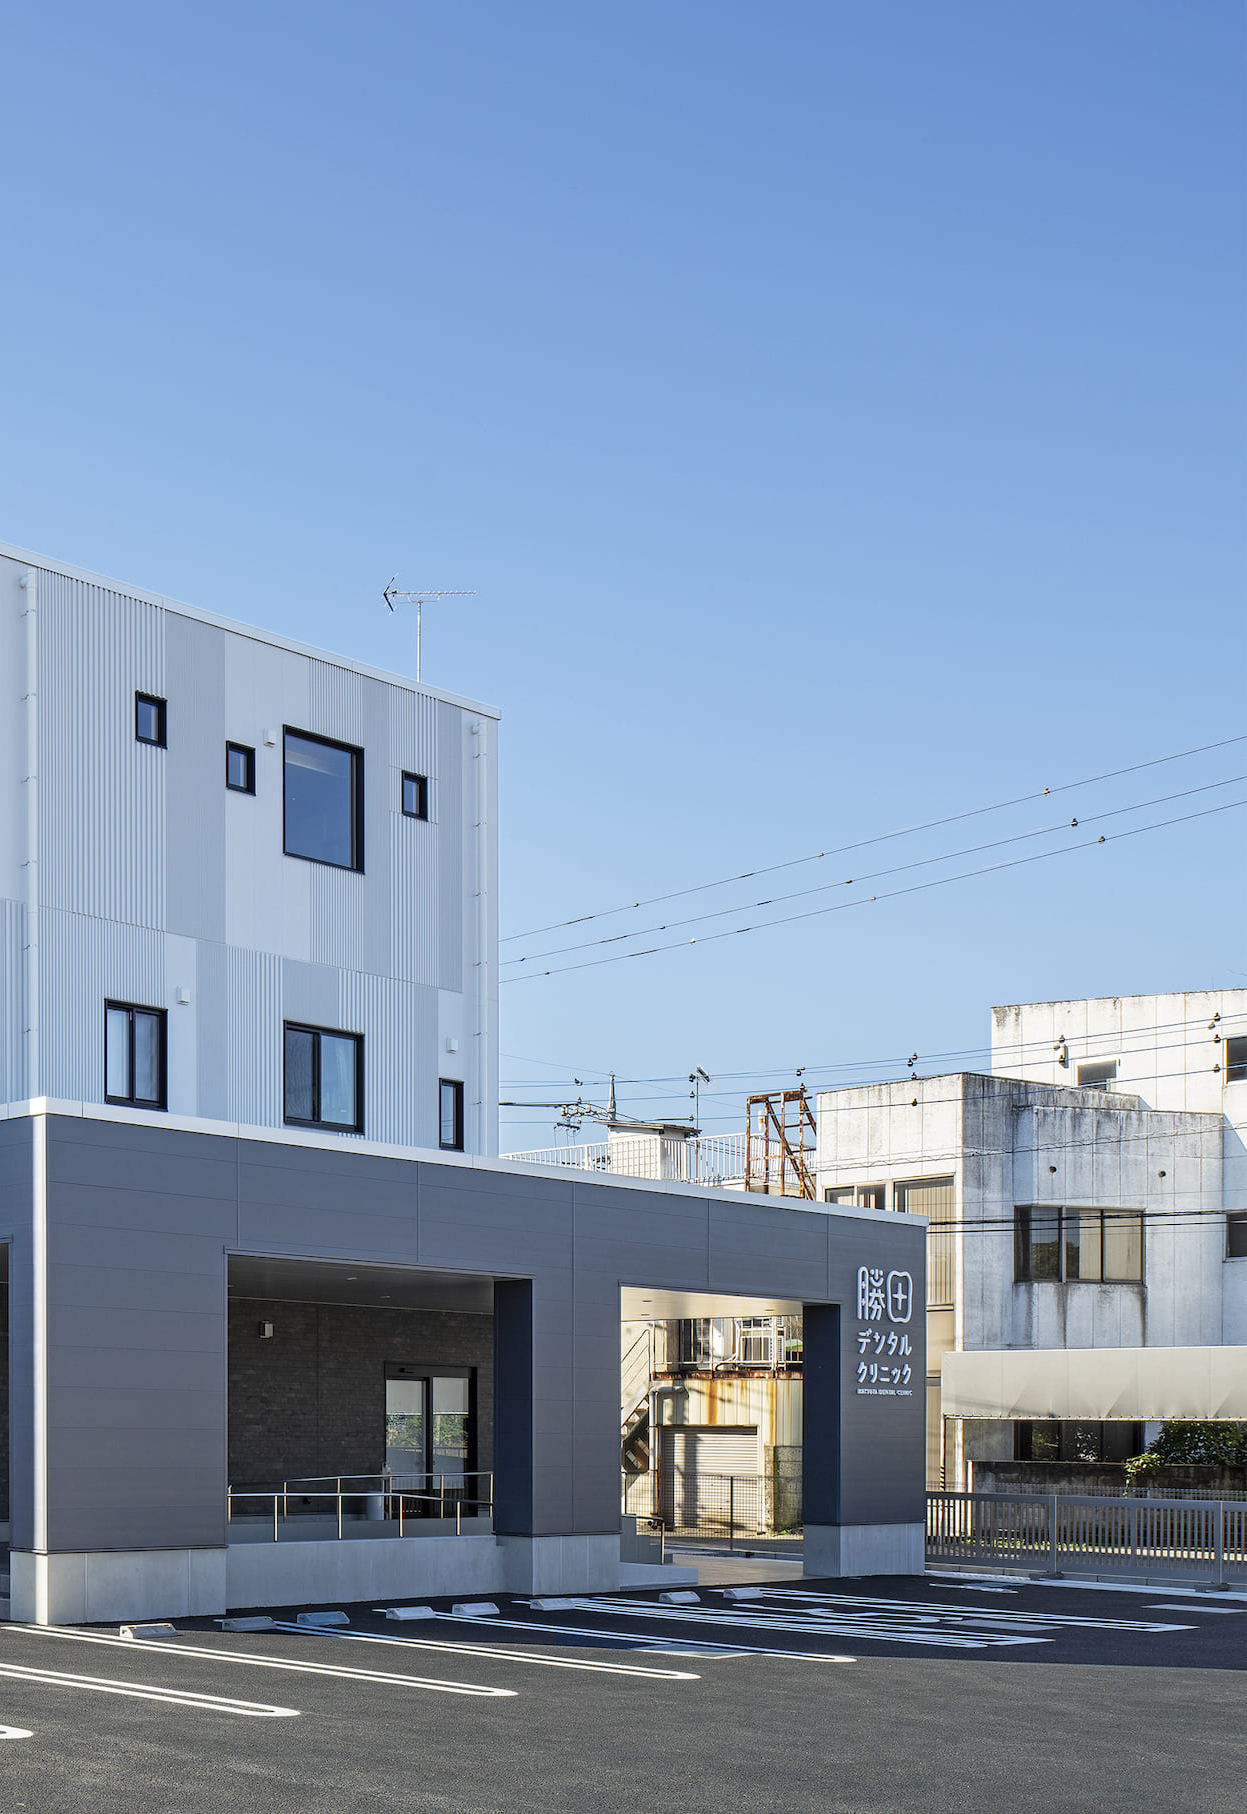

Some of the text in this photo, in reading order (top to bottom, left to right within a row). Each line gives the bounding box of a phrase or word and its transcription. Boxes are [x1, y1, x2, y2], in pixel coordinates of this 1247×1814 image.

[857, 1266, 913, 1323] 勝田
[857, 1328, 912, 1356] デンタル
[857, 1361, 912, 1385] クリニック
